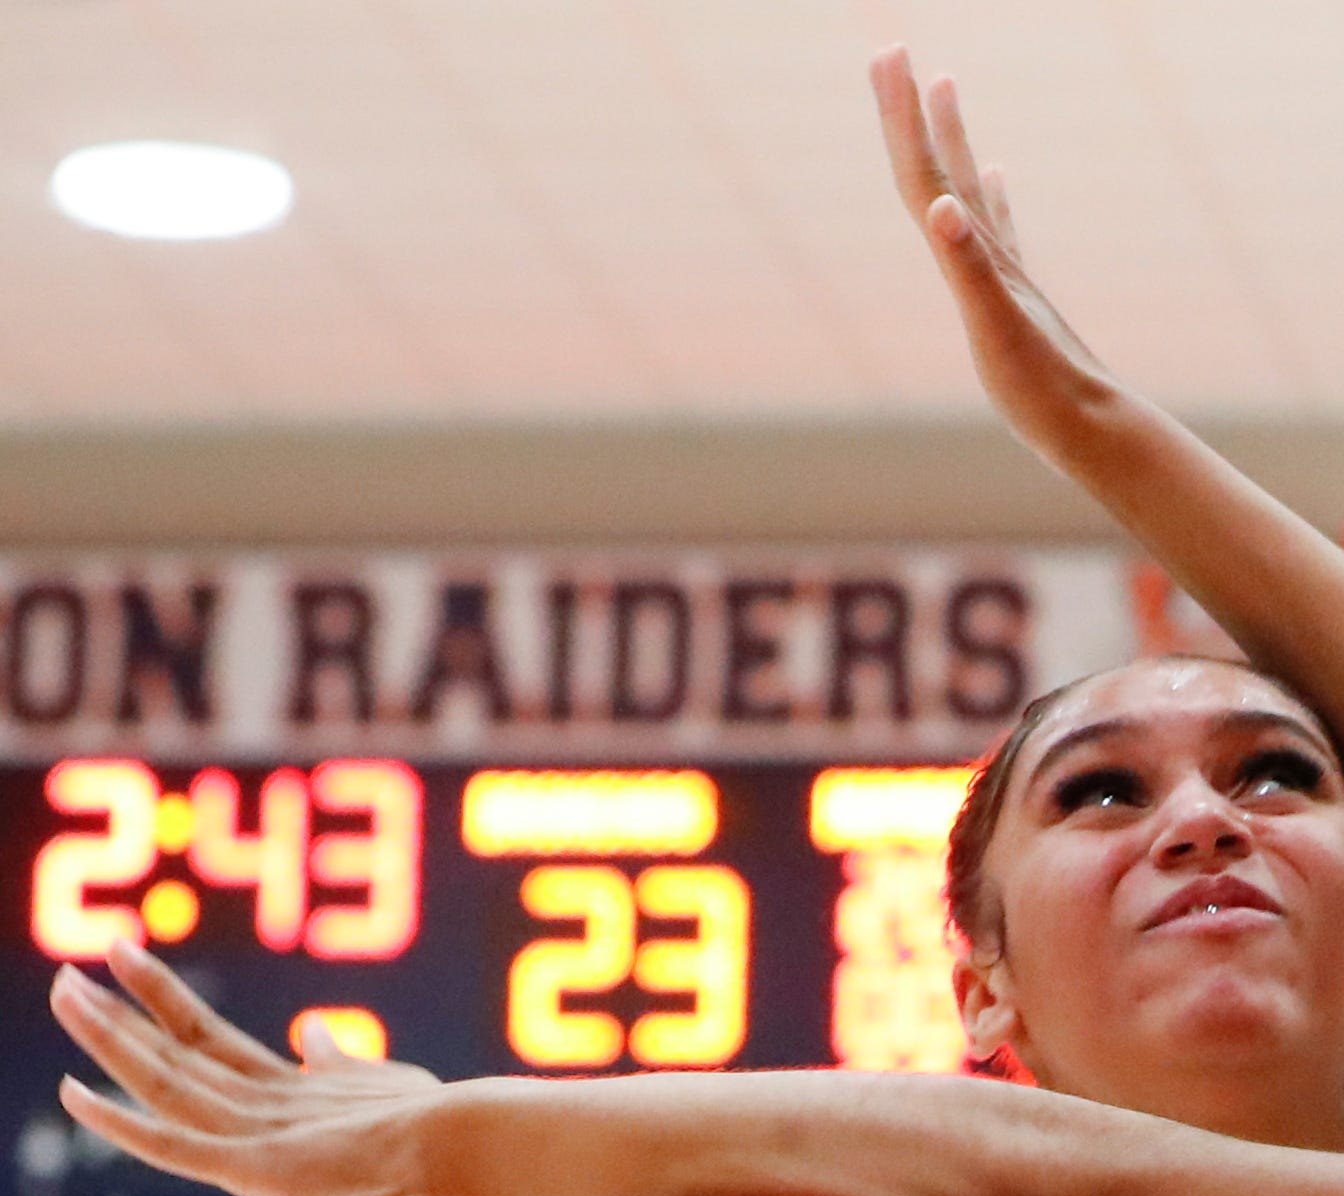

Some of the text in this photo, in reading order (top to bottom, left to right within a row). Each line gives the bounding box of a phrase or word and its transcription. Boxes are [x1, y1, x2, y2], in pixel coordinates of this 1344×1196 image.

[287, 577, 1036, 724] RAIDERS
[33, 758, 423, 961] 2:43
[507, 863, 752, 1067] 23
